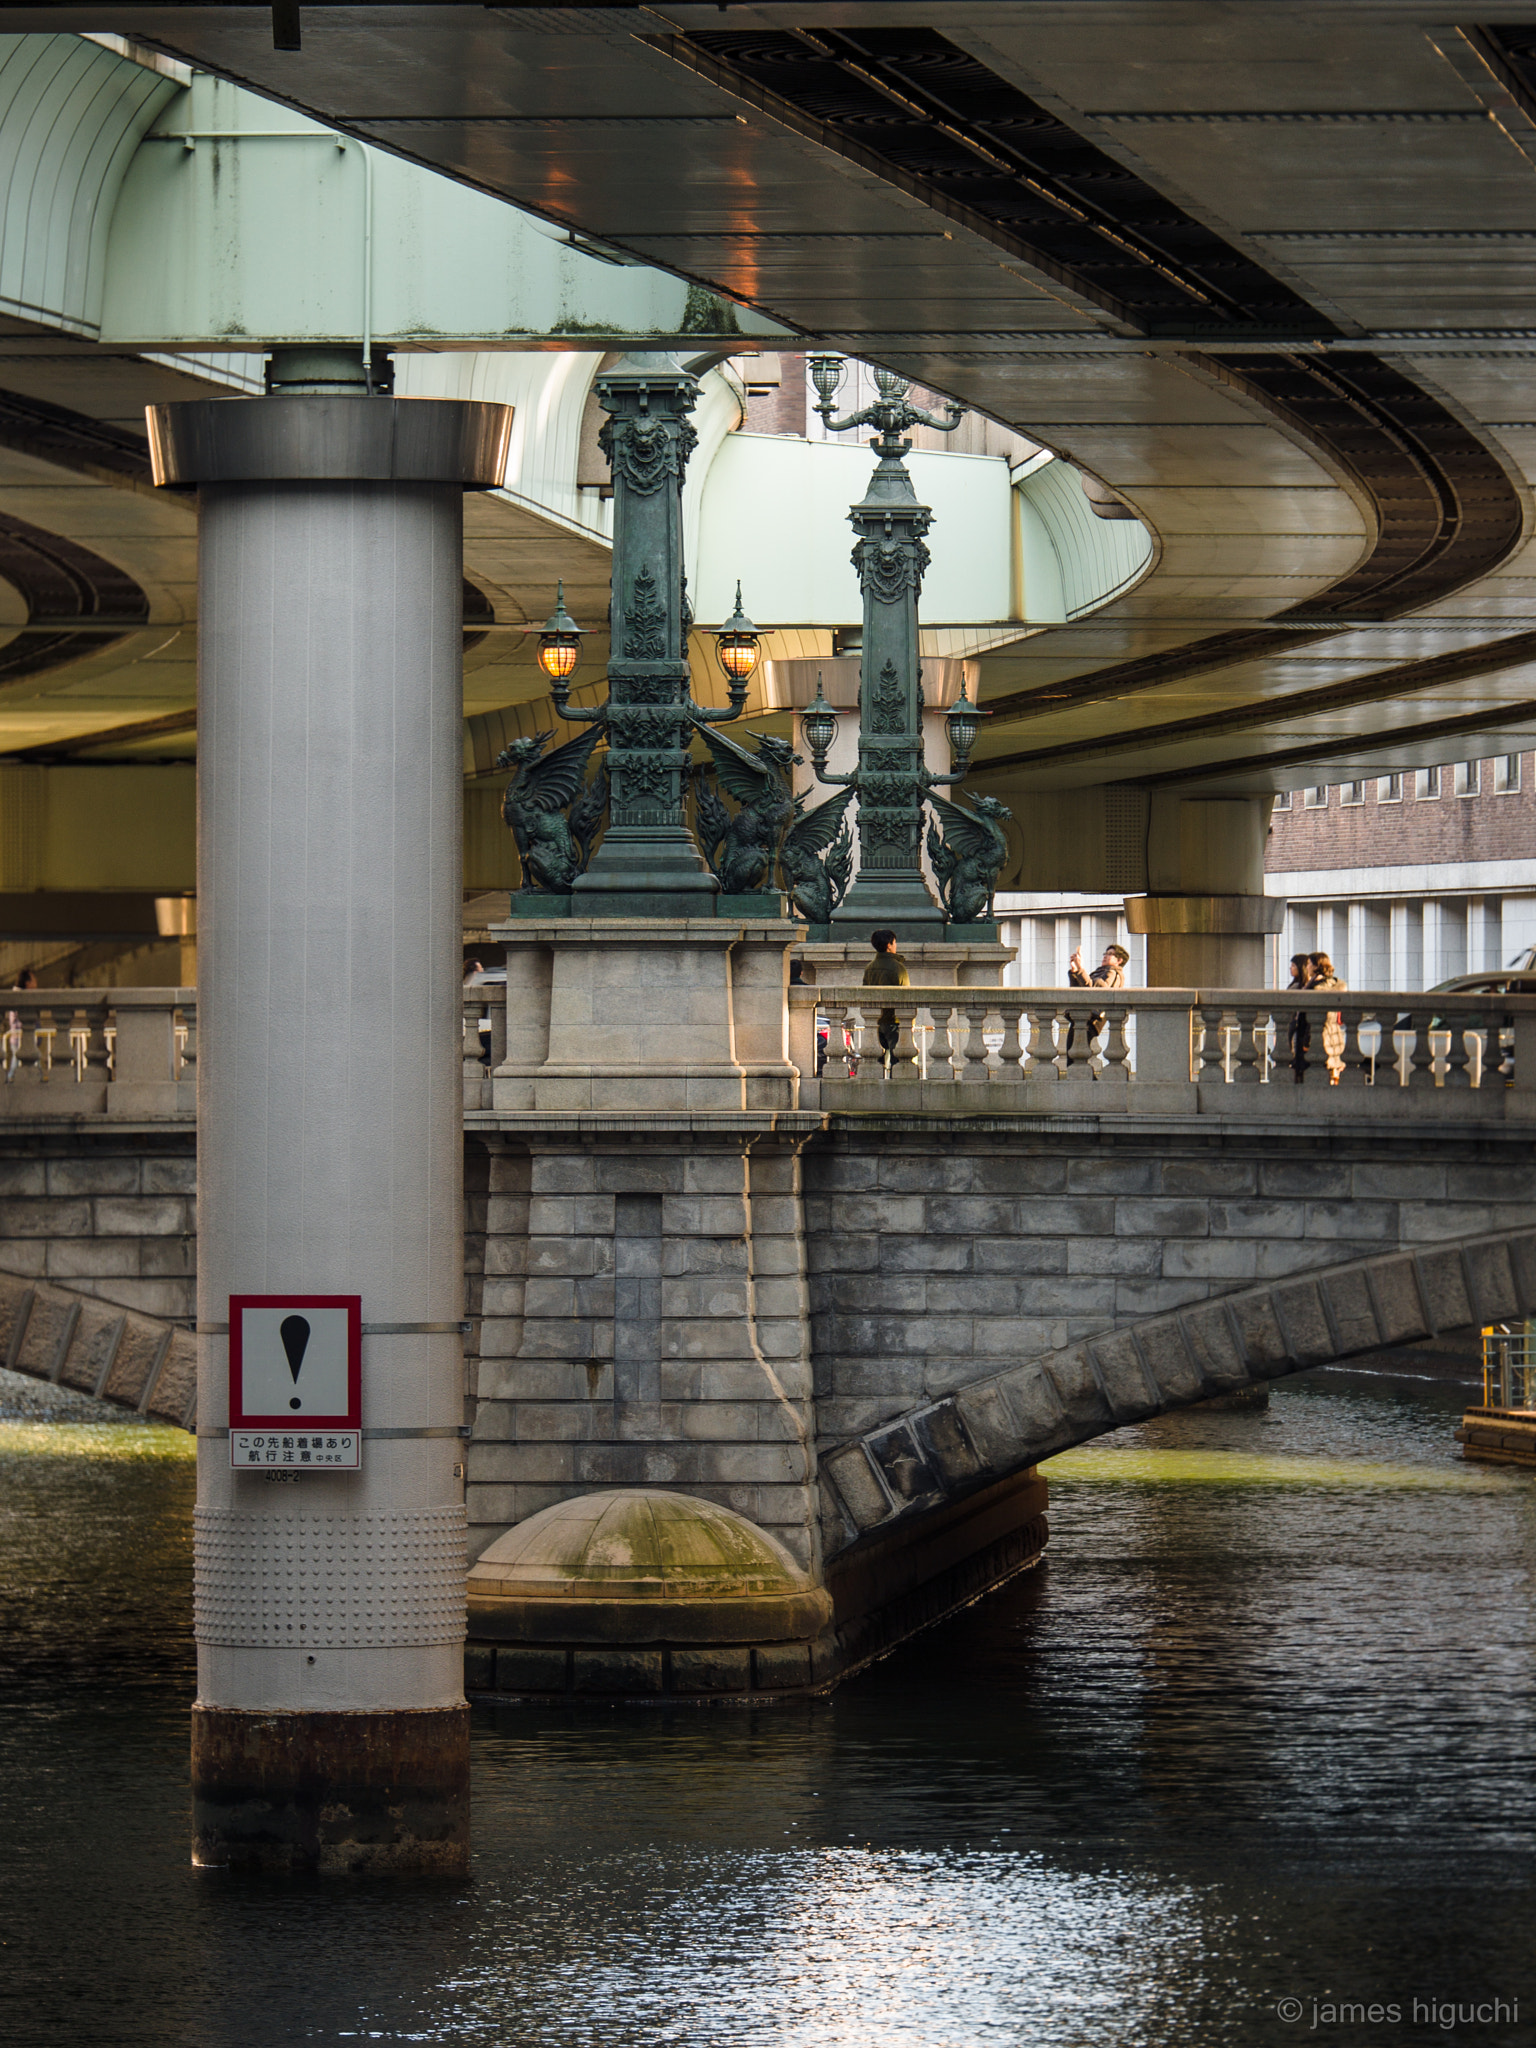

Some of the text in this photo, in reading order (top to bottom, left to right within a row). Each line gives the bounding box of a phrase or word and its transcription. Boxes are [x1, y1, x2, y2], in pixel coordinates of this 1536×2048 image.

[239, 1437, 352, 1449] この先船着場あり
[248, 1450, 343, 1462] 航行注意 中央区
[265, 1469, 299, 1482] 4008-2
